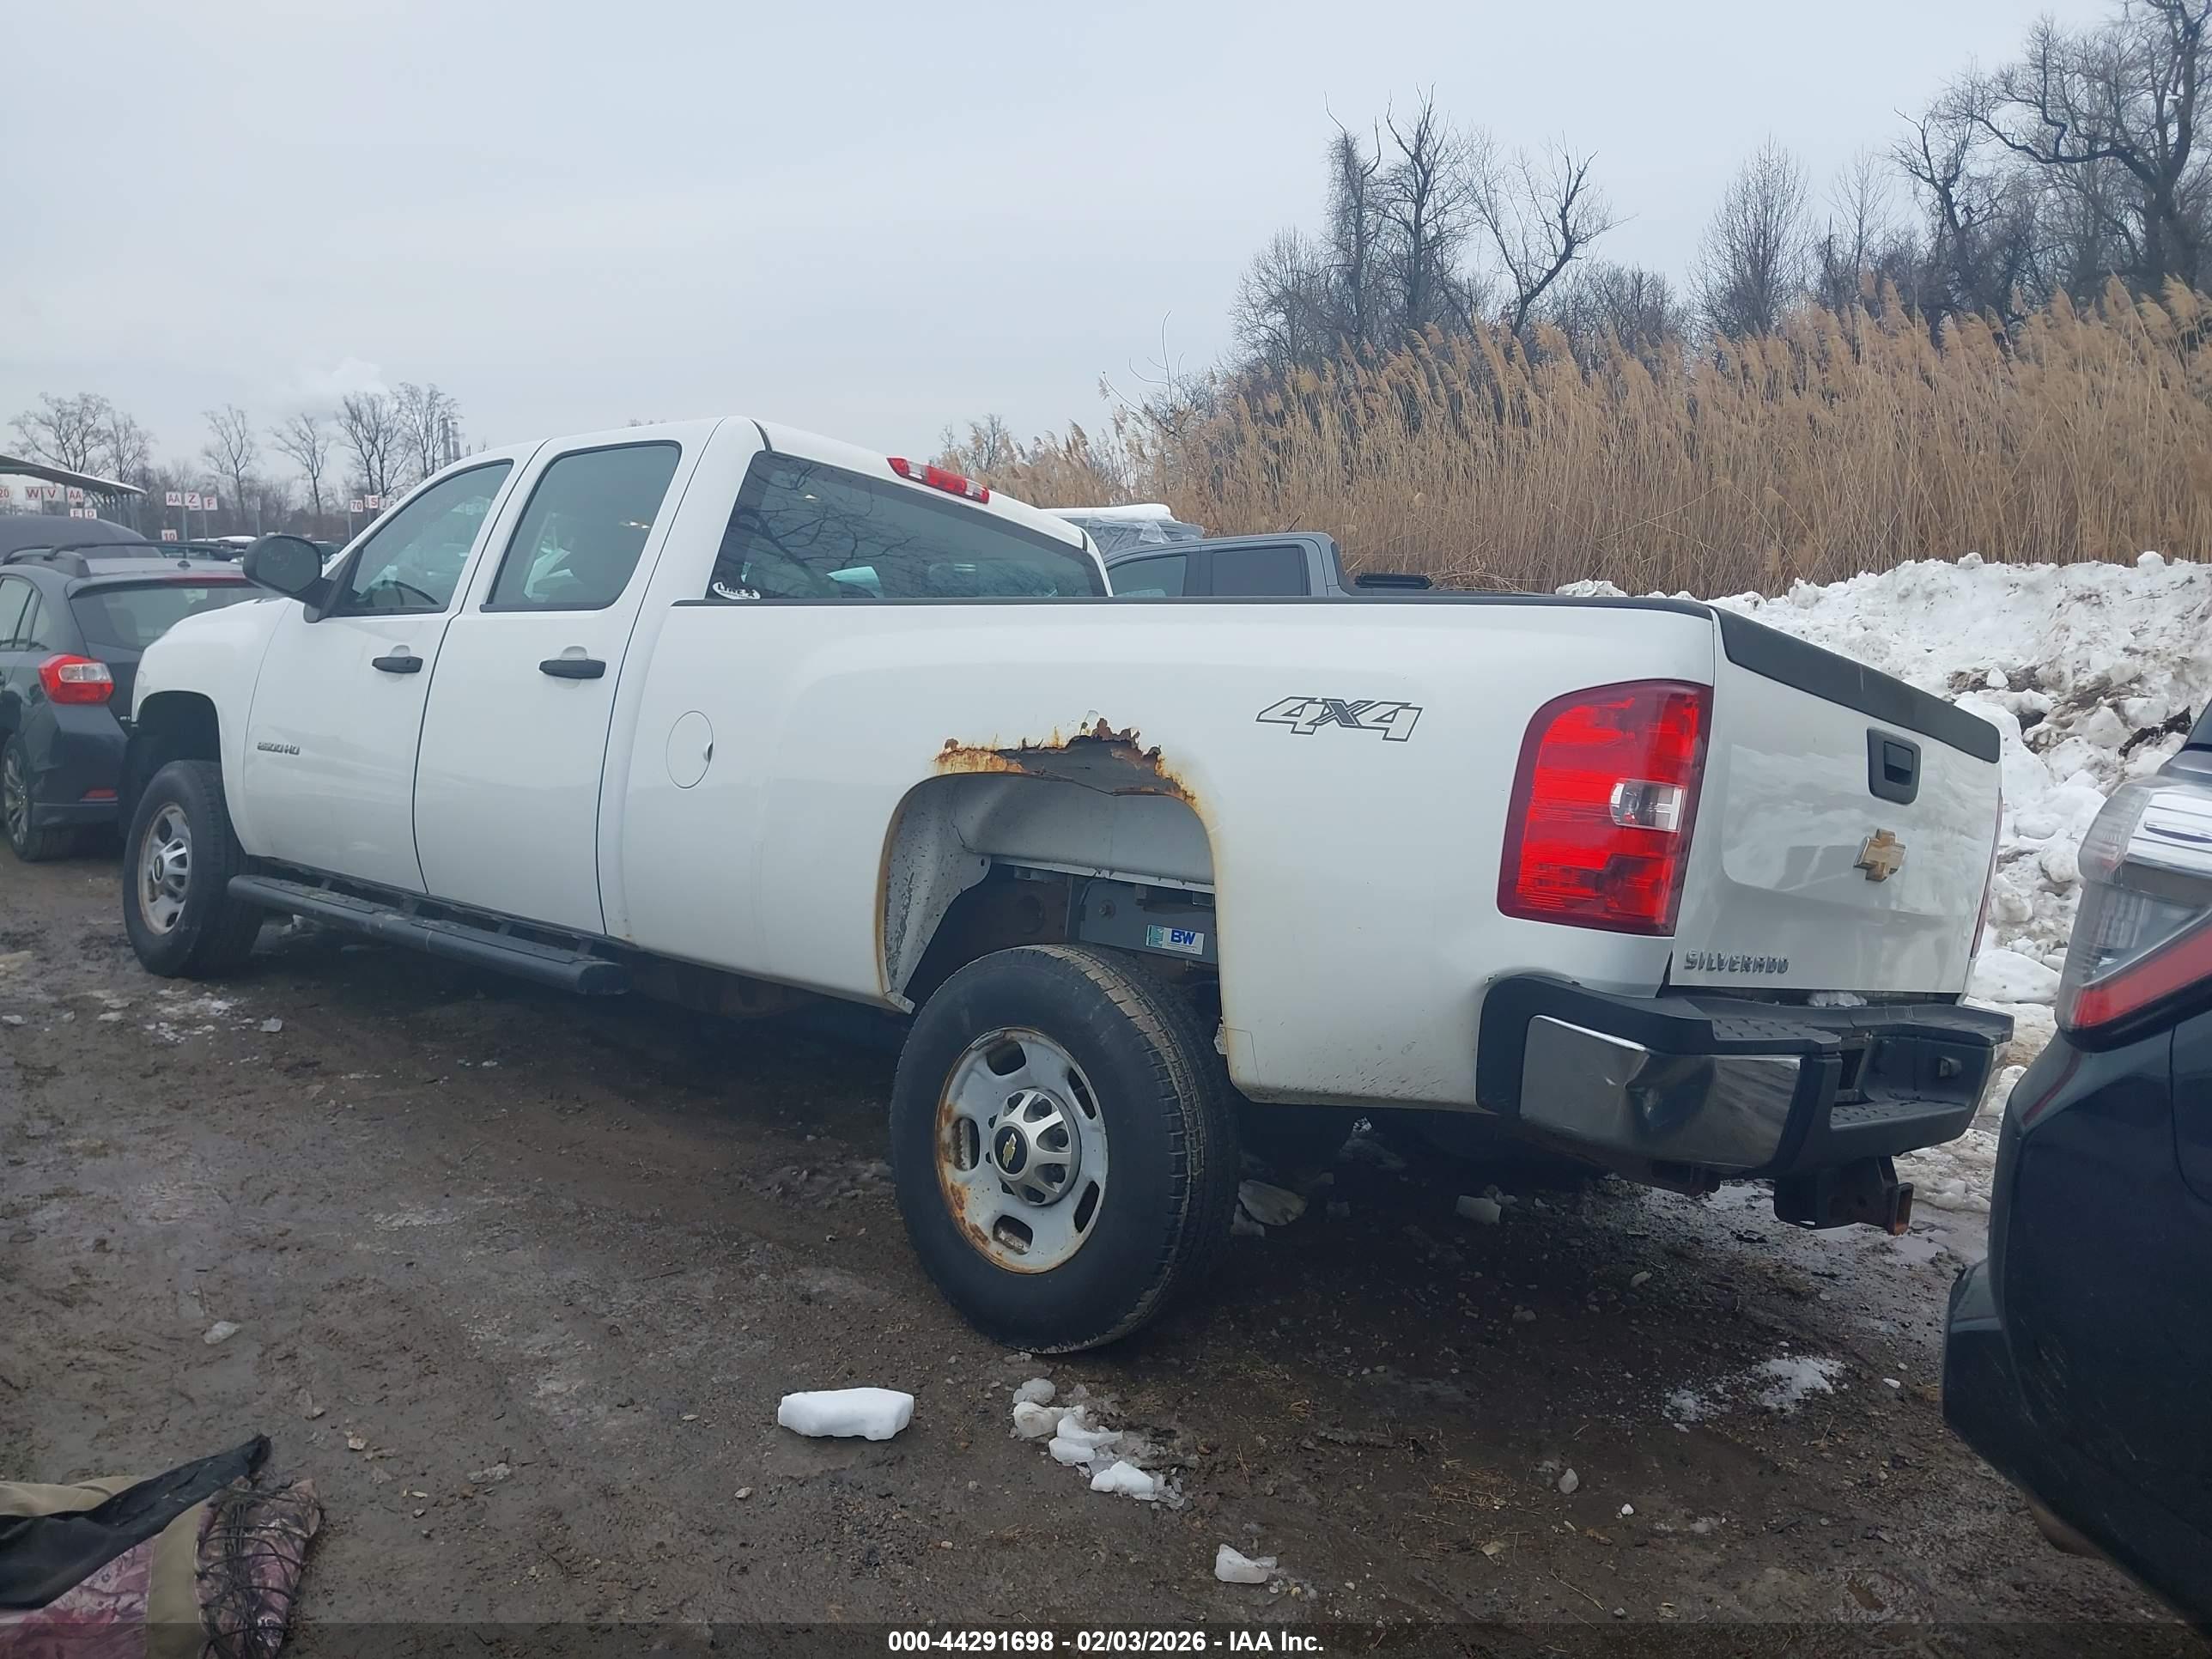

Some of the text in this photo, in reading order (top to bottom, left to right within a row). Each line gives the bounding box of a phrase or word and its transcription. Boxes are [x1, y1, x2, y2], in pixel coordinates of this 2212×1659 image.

[27, 489, 40, 499] W
[47, 489, 56, 499] V
[69, 490, 82, 499] AA
[168, 494, 180, 503] AA
[188, 494, 197, 504] Z
[207, 498, 214, 508] F
[351, 501, 362, 510] 70
[370, 497, 378, 507] S
[165, 532, 175, 541] 10
[1683, 949, 1790, 974] SILVERADO
